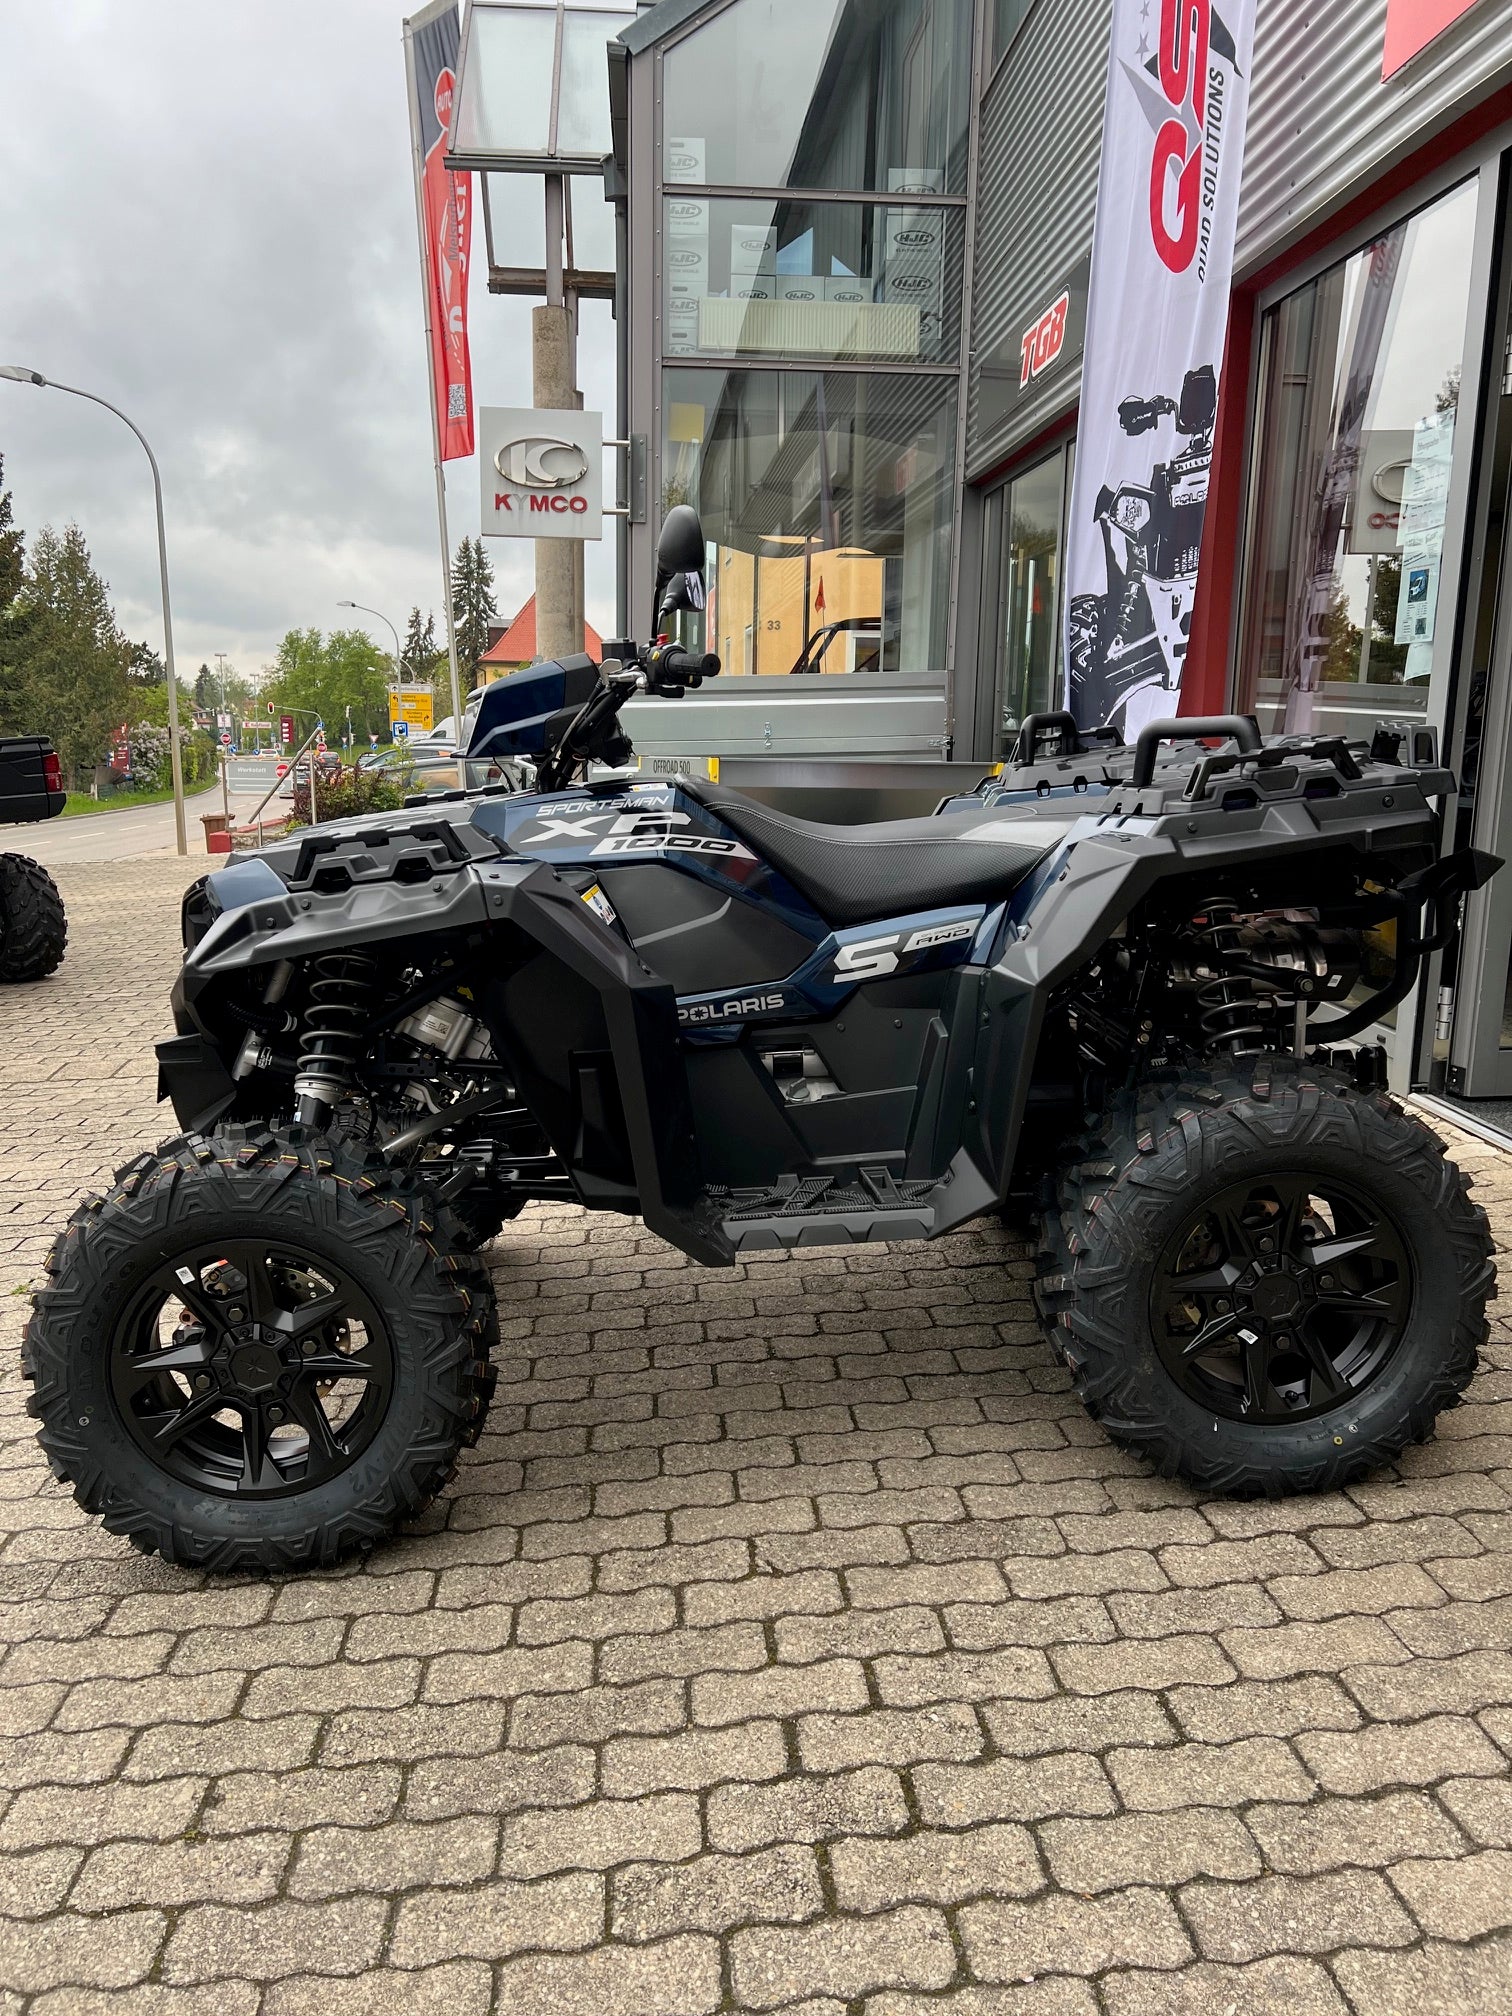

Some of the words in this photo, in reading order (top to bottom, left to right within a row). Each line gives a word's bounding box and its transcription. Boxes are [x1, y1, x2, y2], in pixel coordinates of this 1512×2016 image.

[1203, 67, 1224, 211] SOLUTIONS
[900, 233, 930, 242] HJC
[897, 279, 928, 287] HJC
[742, 291, 765, 299] HJC
[787, 291, 811, 299] HJC
[1020, 292, 1069, 388] TGB
[494, 493, 588, 515] KYMCO
[767, 620, 781, 631] 33
[237, 766, 267, 774] Werkstatt
[653, 759, 678, 775] OFFROAD
[680, 760, 691, 775] 500
[535, 795, 669, 818] SPORTSMAN
[519, 811, 693, 844] XP
[610, 836, 738, 853] 1000
[915, 927, 970, 946] AWD
[677, 993, 785, 1022] POLARIS
